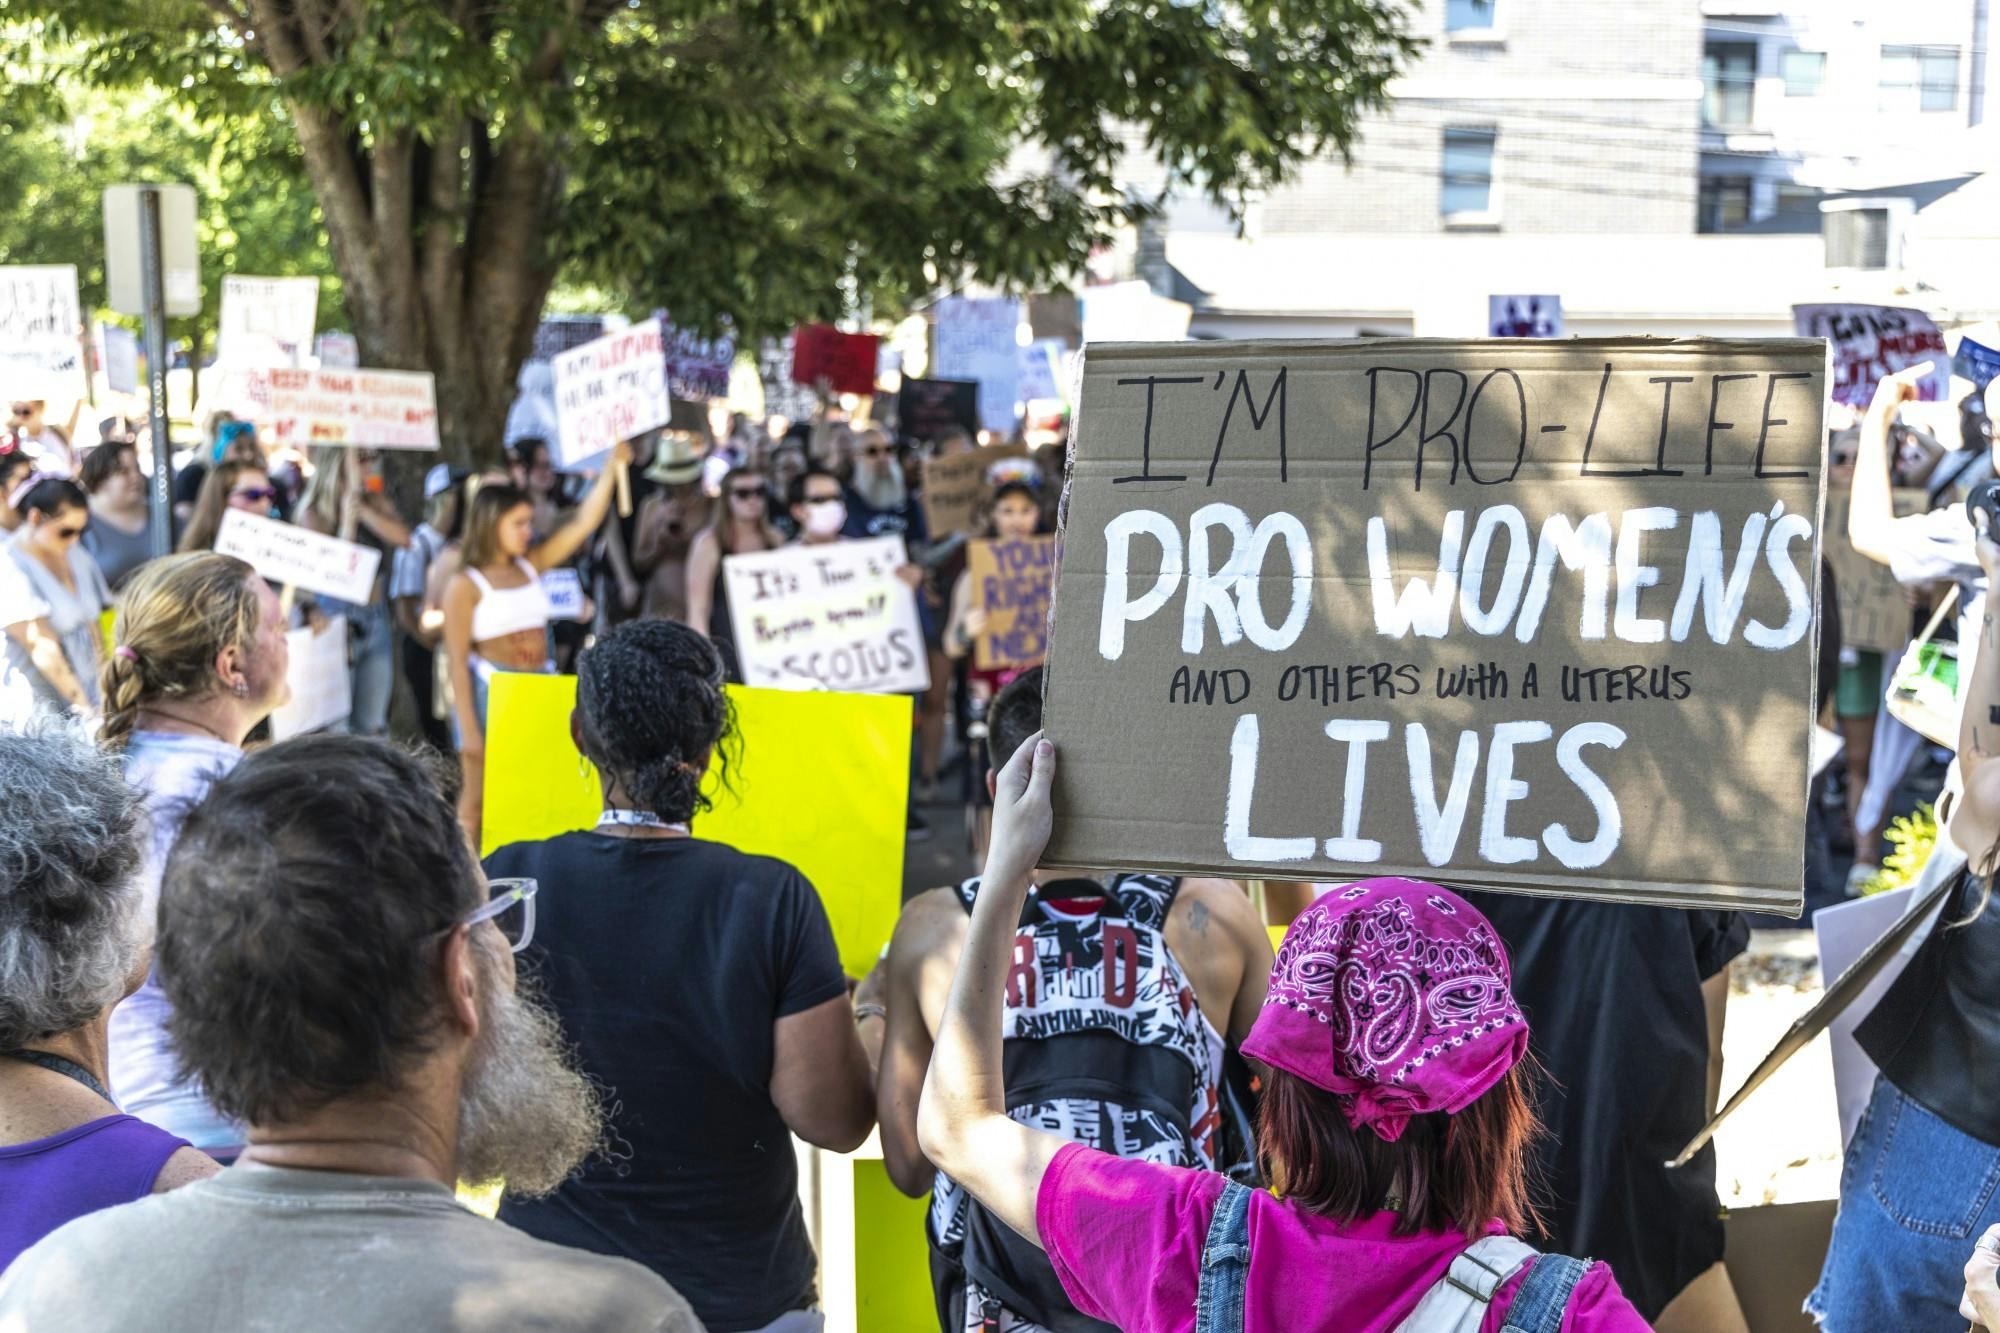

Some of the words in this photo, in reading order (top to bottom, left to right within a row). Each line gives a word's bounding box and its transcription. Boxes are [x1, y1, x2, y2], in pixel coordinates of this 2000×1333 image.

[1112, 366, 1287, 487] I'M
[1363, 363, 1812, 491] PRO-LIFE
[1099, 502, 1313, 660] PRO
[1367, 499, 1813, 650] WOMEN'S
[782, 628, 915, 682] SCOTUS
[1169, 665, 1250, 704] AND
[1278, 663, 1420, 705] OTHERS
[1520, 662, 1539, 699] A
[1561, 665, 1692, 703] UTERUS
[1223, 713, 1628, 870] LIVES
